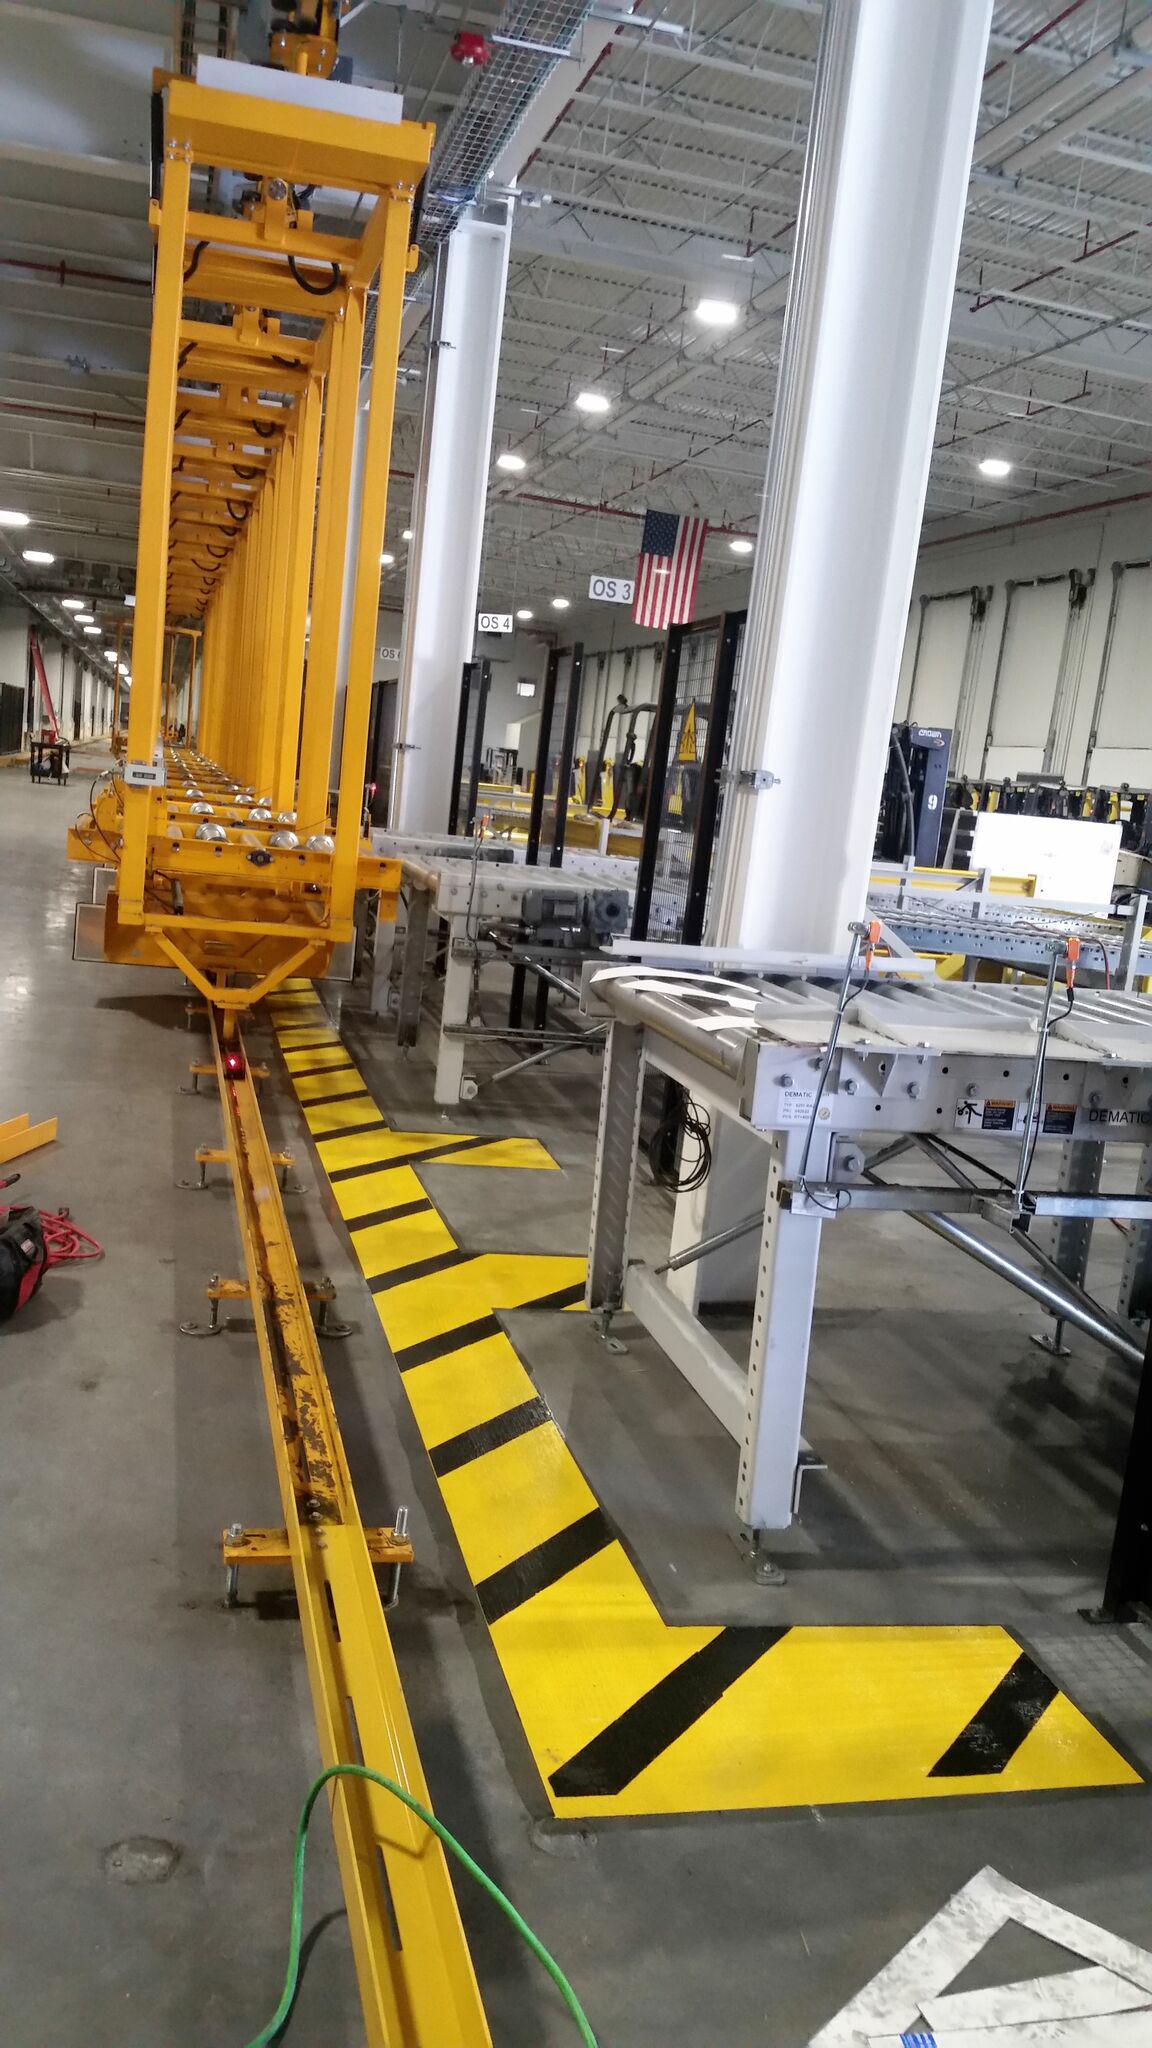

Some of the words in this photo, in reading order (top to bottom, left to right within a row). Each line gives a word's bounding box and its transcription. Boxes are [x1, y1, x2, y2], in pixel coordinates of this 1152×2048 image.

[593, 579, 617, 598] OS
[622, 583, 631, 600] 3
[481, 616, 499, 629] OS
[503, 617, 510, 629] 4
[382, 648, 395, 659] OS
[927, 794, 938, 810] 9
[1089, 1110, 1151, 1124] DEMATIC
